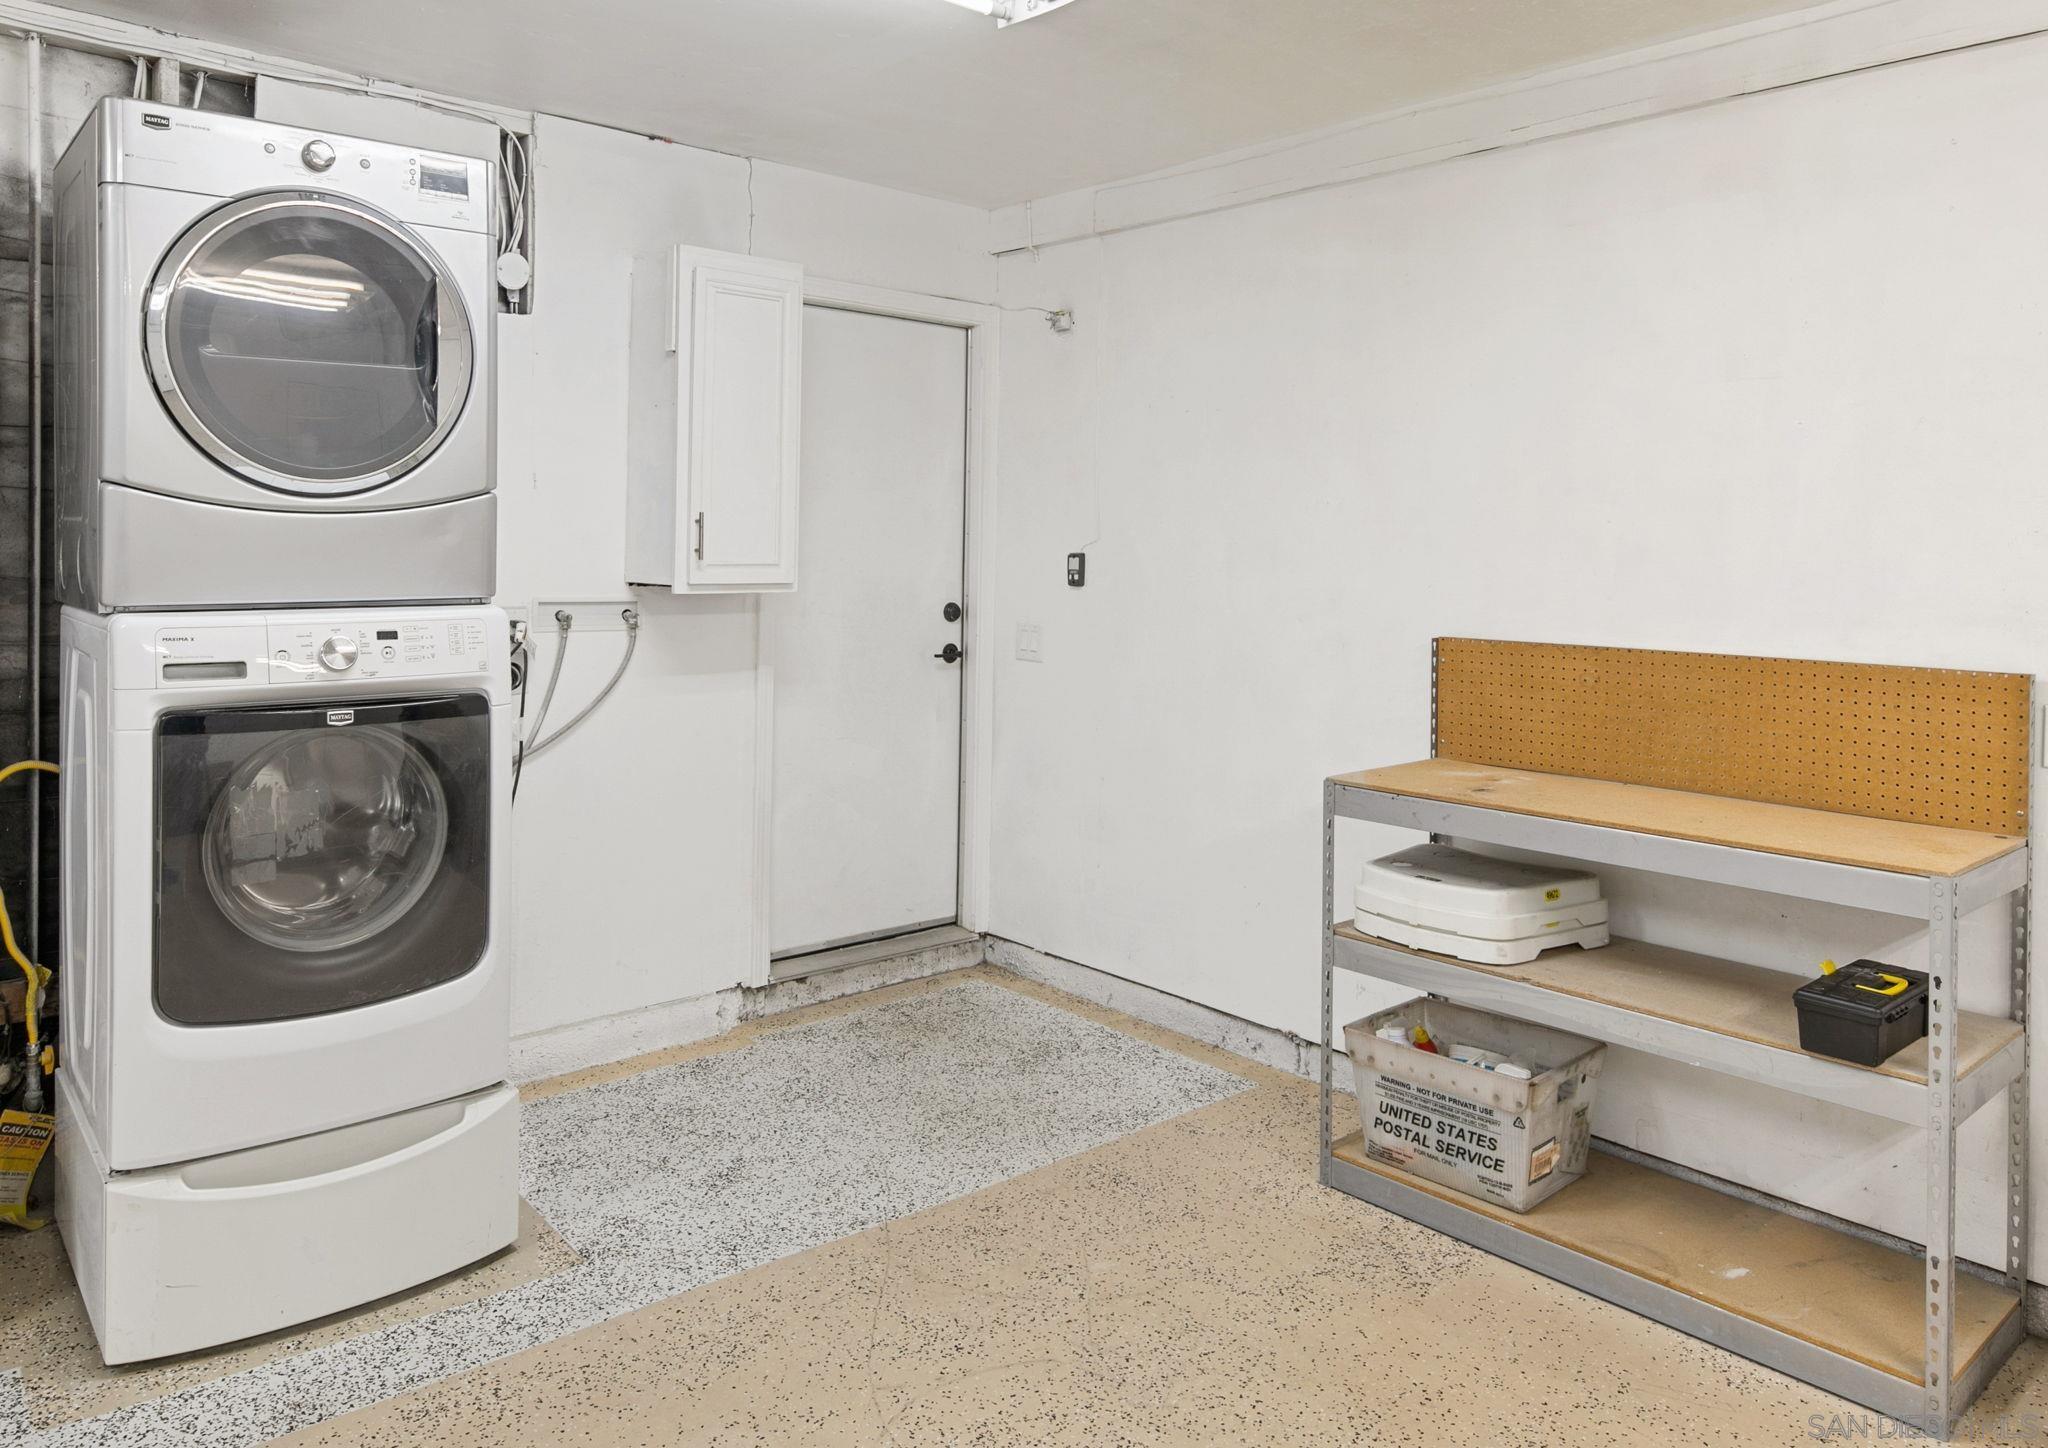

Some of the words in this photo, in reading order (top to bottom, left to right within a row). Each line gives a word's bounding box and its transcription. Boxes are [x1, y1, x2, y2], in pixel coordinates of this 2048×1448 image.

[145, 116, 169, 125] MAYTAG
[1380, 1074, 1411, 1091] WARNING
[1416, 1087, 1430, 1097] NOT
[1432, 1091, 1447, 1102] FOR
[1448, 1097, 1477, 1113] PRIVATE
[1479, 1107, 1494, 1117] USE
[1, 1125, 48, 1137] CAUTION
[1380, 1100, 1431, 1129] UNITED
[1436, 1120, 1498, 1151] STATES
[1374, 1116, 1430, 1148] POSTAL
[1435, 1139, 1505, 1173] SERVICE
[1413, 1147, 1425, 1157] FOR
[1426, 1151, 1439, 1161] MAIL
[1441, 1156, 1457, 1168] ONLY
